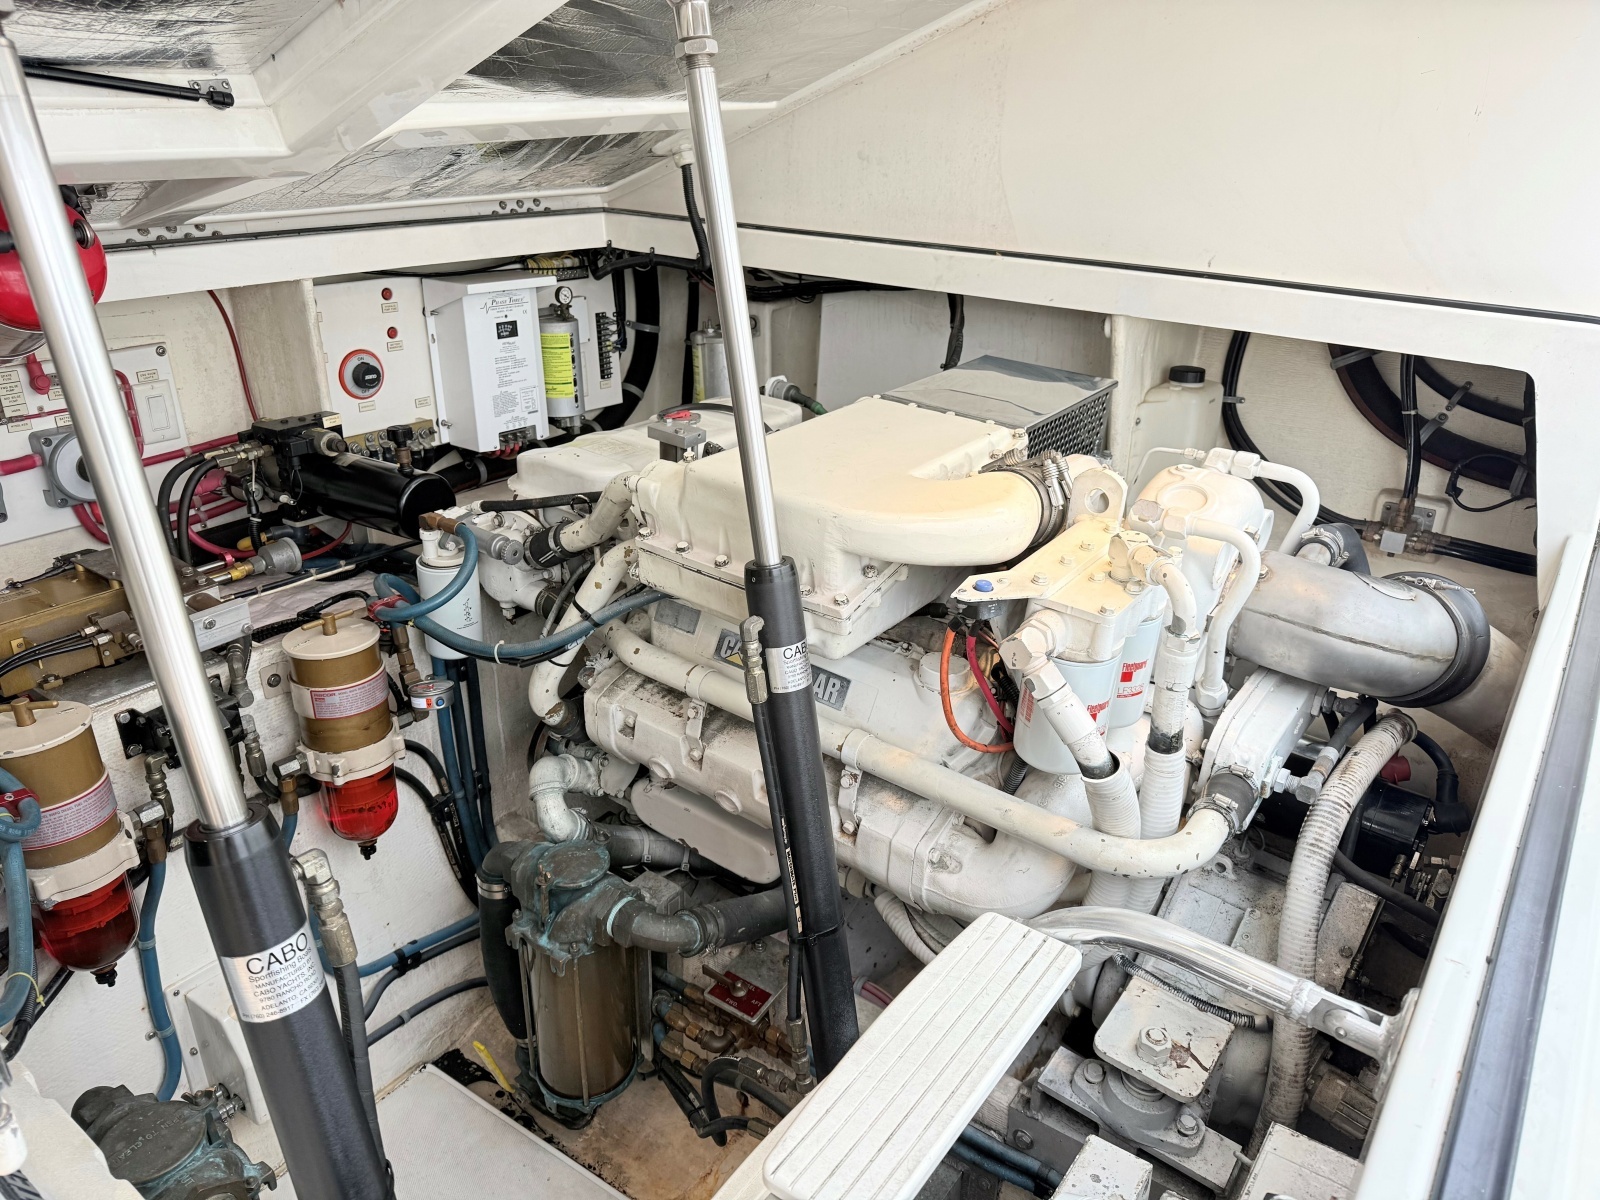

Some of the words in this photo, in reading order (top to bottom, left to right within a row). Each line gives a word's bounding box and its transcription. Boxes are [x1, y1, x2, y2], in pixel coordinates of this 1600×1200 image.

[782, 641, 808, 660] CAB
[246, 932, 308, 975] CABO
[248, 961, 297, 984] Sportfishing
[254, 963, 306, 989] MANUFACTURED
[254, 987, 276, 998] CABO
[276, 982, 304, 998] RANCHO
[304, 970, 317, 983] ROAD
[299, 988, 308, 996] CA
[751, 999, 762, 1007] AFT
[145, 1130, 160, 1140] TO
